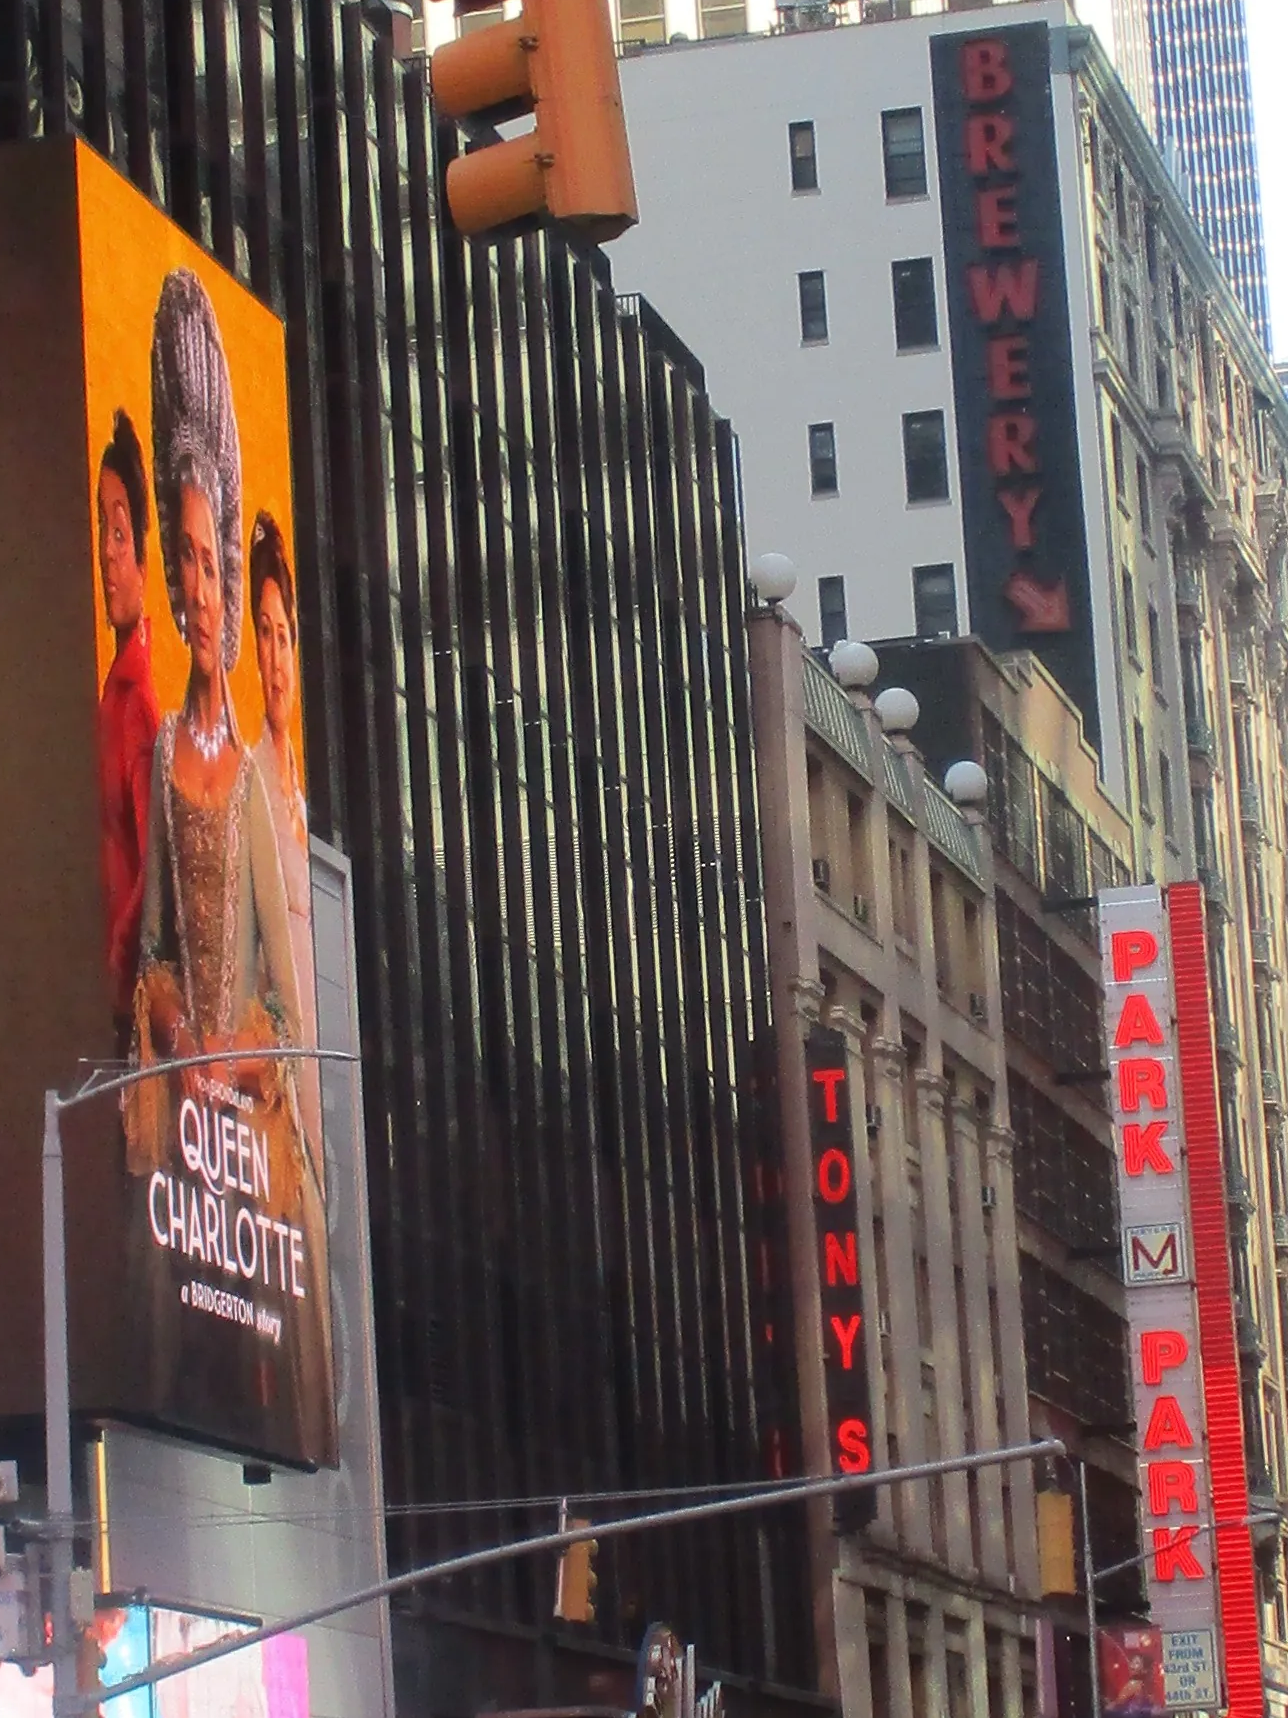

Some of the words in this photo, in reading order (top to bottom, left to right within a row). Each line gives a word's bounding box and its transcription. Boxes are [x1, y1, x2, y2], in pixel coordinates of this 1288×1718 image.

[958, 37, 1039, 551] BREWERY
[1111, 929, 1175, 1178] PARK
[180, 1098, 270, 1202] QUEEN
[148, 1171, 306, 1298] CHARLOTTE
[812, 1068, 871, 1475] TONYS
[181, 1283, 189, 1304] a
[191, 1281, 254, 1326] BRIDGERTON
[1139, 1330, 1205, 1583] PARK
[1168, 1647, 1204, 1660] FROM
[1172, 1634, 1198, 1646] EXIT
